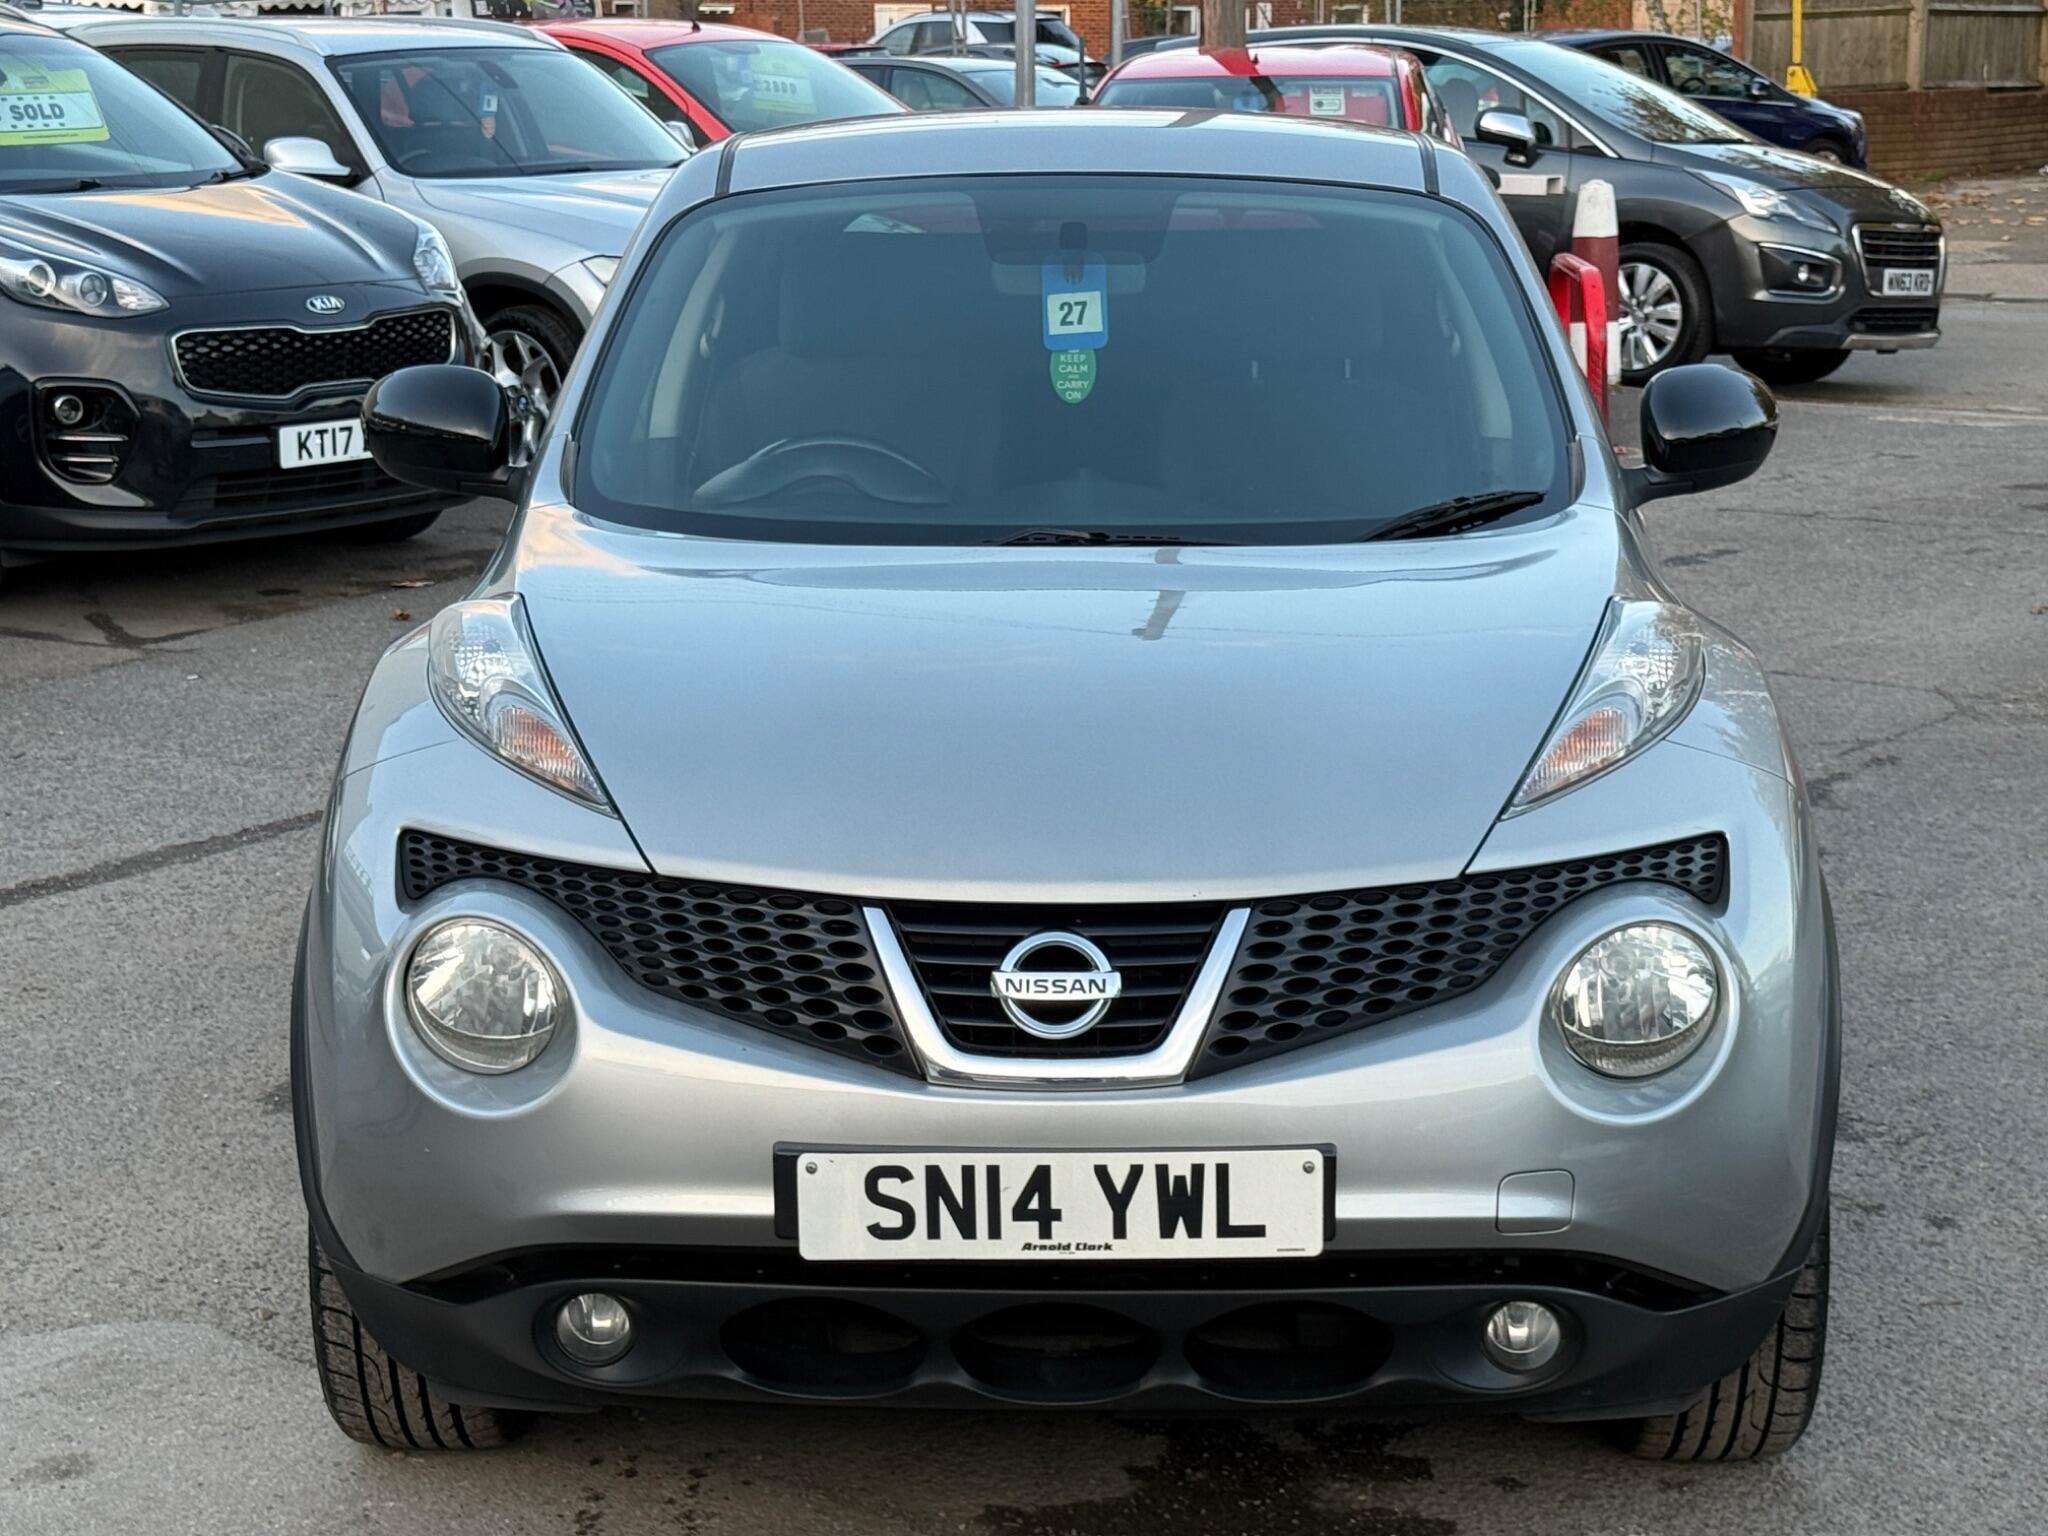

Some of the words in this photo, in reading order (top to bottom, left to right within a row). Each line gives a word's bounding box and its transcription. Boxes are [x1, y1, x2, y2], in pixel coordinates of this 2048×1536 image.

[9, 103, 65, 121] SOLD
[311, 296, 341, 310] KIA
[1059, 301, 1088, 326] 27
[1060, 354, 1086, 363] KEEP
[1058, 364, 1088, 373] CALM
[1056, 380, 1089, 389] CARRY
[1065, 391, 1082, 400] ON
[297, 426, 353, 460] KT17
[1005, 978, 1107, 994] NISSAN
[864, 1164, 1063, 1241] SN14
[1093, 1163, 1267, 1240] YWL
[1021, 1242, 1071, 1251] Arnold
[1075, 1242, 1113, 1251] Clark
